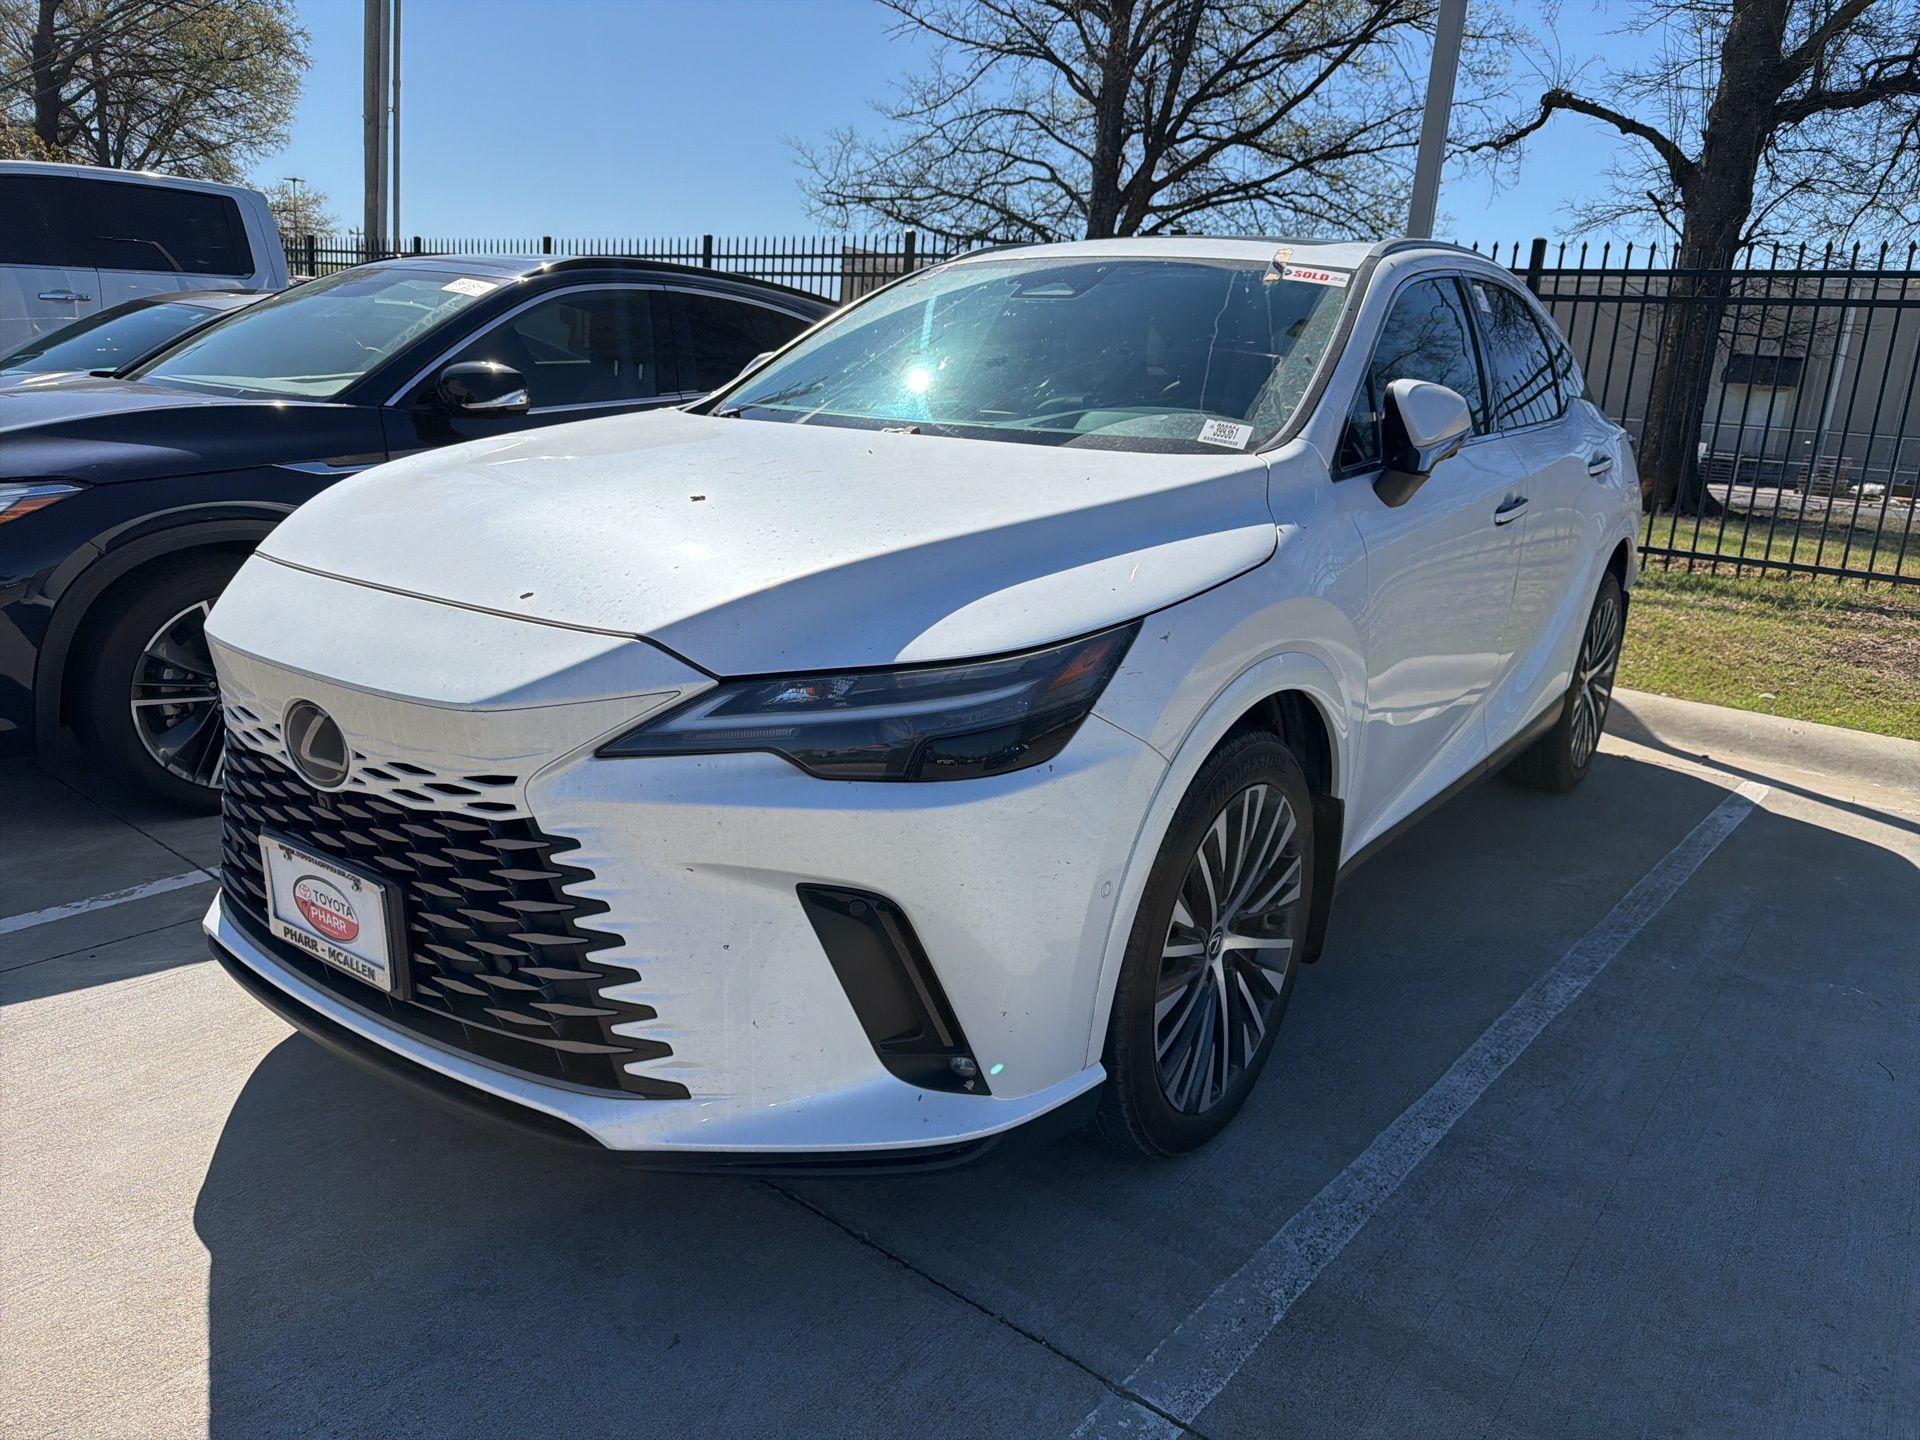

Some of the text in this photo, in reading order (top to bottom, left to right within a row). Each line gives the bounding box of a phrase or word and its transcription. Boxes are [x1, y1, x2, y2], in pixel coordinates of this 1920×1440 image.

[1293, 270, 1330, 281] SOLD
[312, 890, 354, 919] TOYOTA
[311, 906, 347, 933] PHARR
[283, 926, 319, 953] PHARR
[328, 946, 376, 981] MCALLEN
